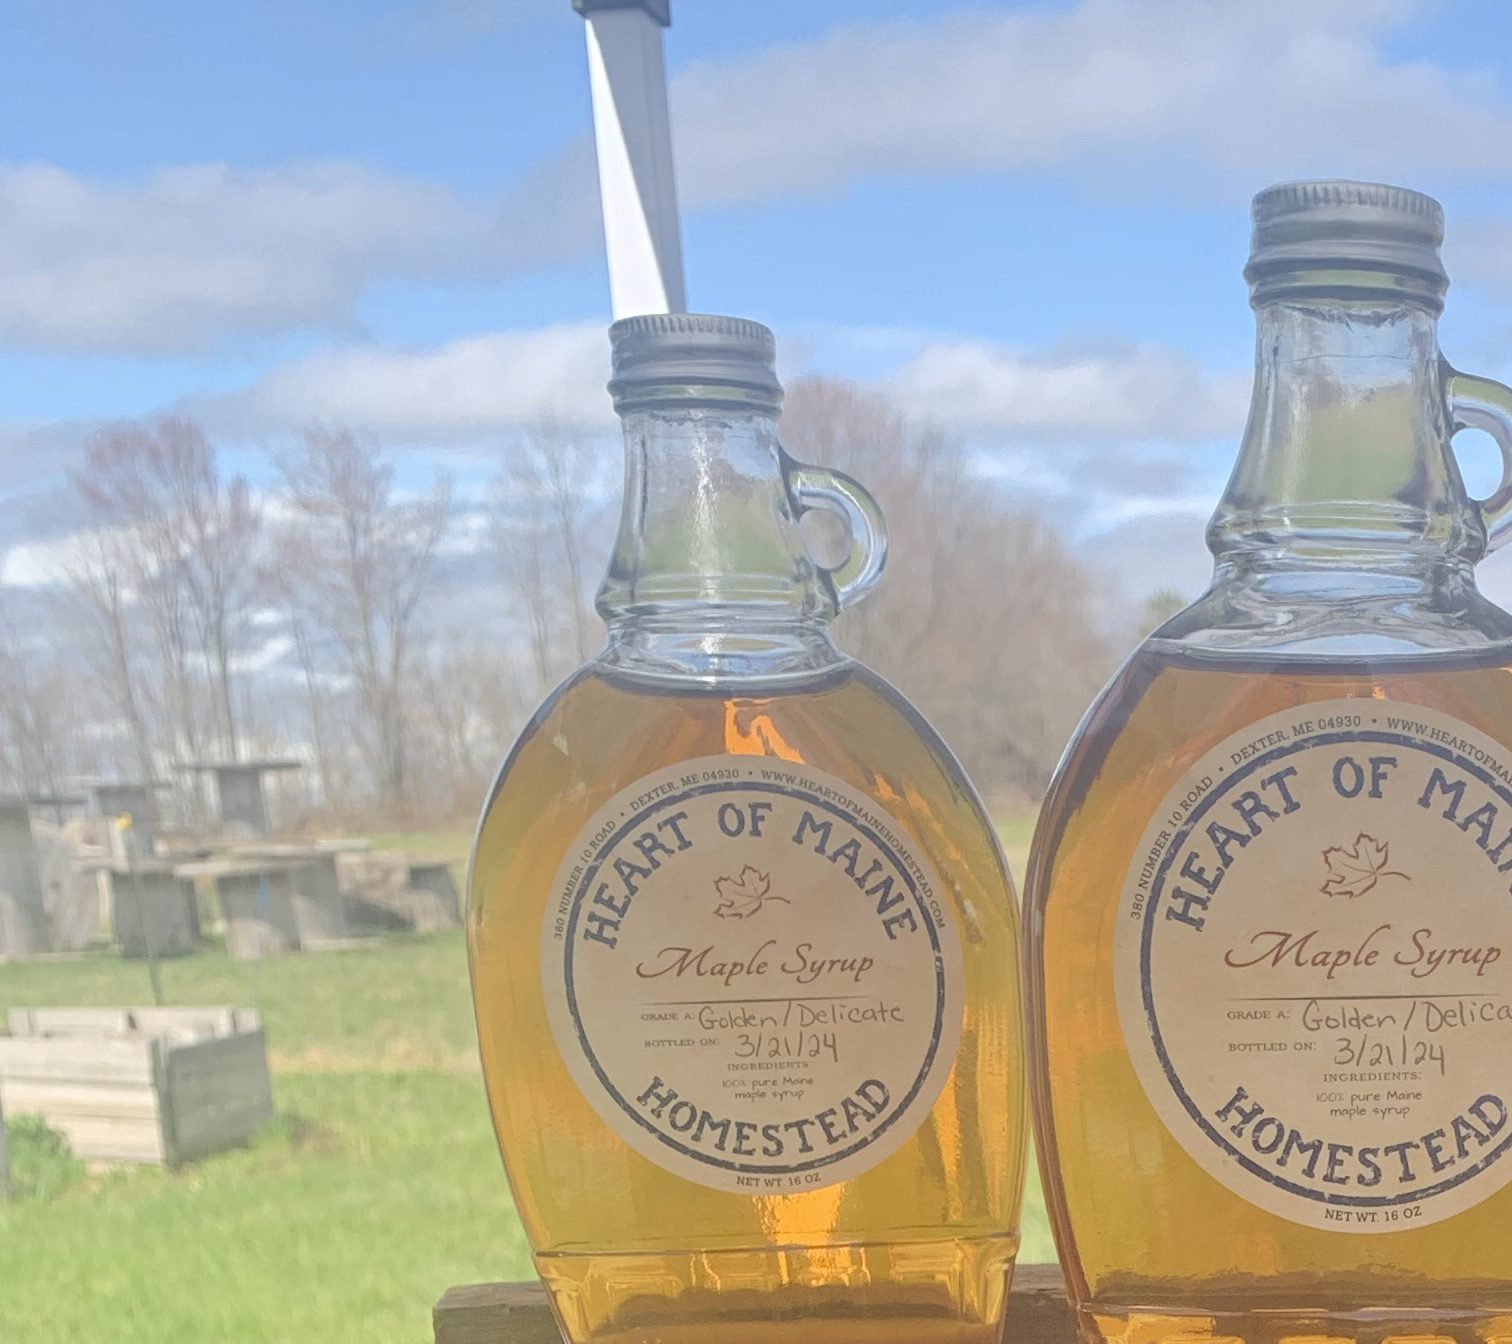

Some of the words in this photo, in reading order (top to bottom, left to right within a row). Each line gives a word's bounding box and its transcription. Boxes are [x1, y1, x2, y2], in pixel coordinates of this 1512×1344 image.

[679, 773, 700, 787] ME
[701, 768, 739, 781] 04930
[1129, 892, 1144, 920] 380
[1137, 829, 1171, 890] NUMBER
[1167, 810, 1183, 828] 10
[1179, 775, 1212, 811] ROAD
[1229, 729, 1290, 765] DEXTER,
[1290, 720, 1315, 736] ME
[1317, 714, 1361, 730] 04930
[588, 820, 616, 850] ROAD
[1165, 766, 1300, 931] HEART
[1332, 755, 1397, 799] OF
[579, 849, 593, 864] 10
[583, 811, 692, 949] HEART
[716, 801, 772, 837] OF
[791, 810, 917, 940] MAINE
[557, 865, 584, 915] NUMBER
[553, 917, 565, 940] 380
[1223, 923, 1391, 979] Maple
[1393, 928, 1501, 978] Syrup
[635, 939, 776, 986] Maple
[780, 942, 874, 984] Syrup
[1226, 1010, 1272, 1021] GRADE
[1227, 1042, 1289, 1053] BOTTLED
[1322, 1072, 1423, 1083] INGREDIENTS:
[1350, 1091, 1381, 1109] pure
[1385, 1090, 1423, 1101] Maine
[636, 1076, 889, 1157] HOMESTEAD
[1329, 1105, 1368, 1120] maple
[1372, 1105, 1411, 1119] syrup
[1215, 1087, 1507, 1186] HOMESTEAD
[735, 1175, 761, 1187] NET
[787, 1175, 801, 1186] 16
[803, 1171, 821, 1184] OZ
[1323, 1207, 1353, 1222] NET
[1383, 1209, 1398, 1222] 16
[1402, 1205, 1422, 1219] OZ
